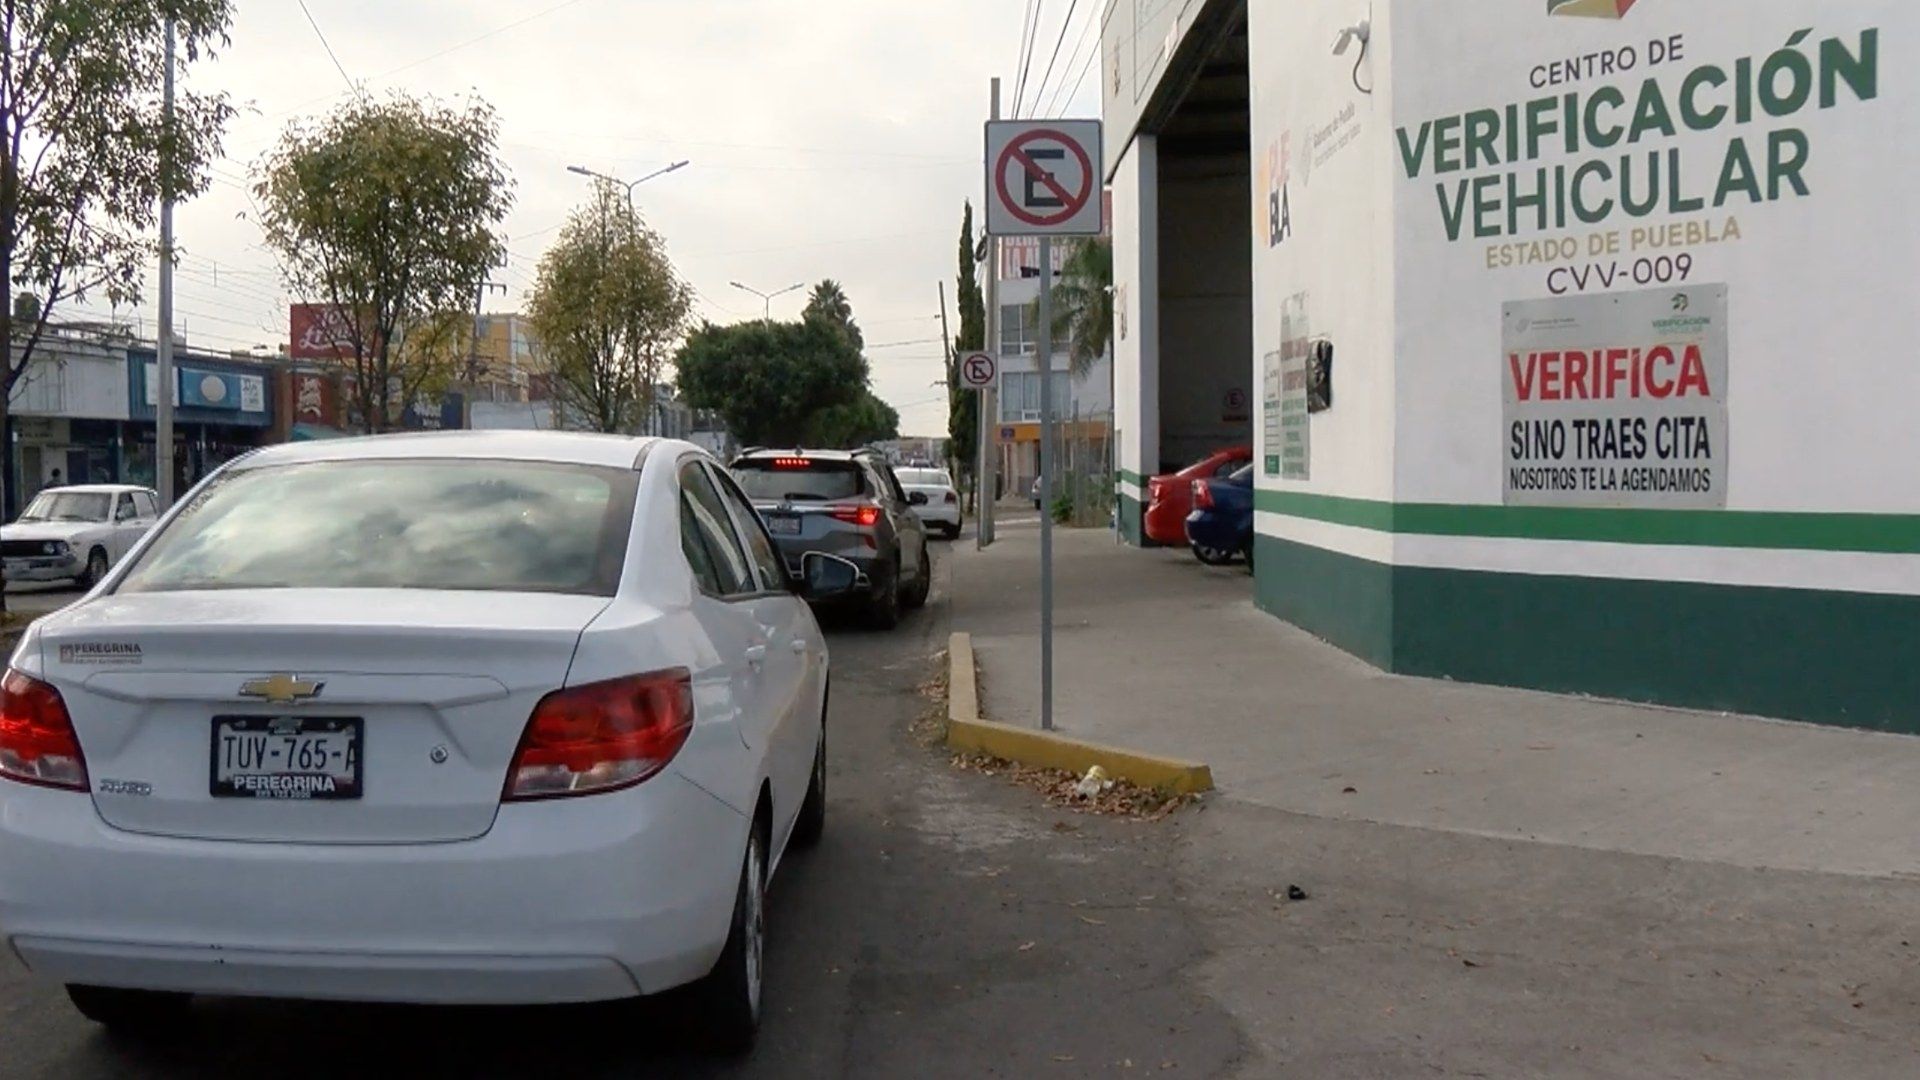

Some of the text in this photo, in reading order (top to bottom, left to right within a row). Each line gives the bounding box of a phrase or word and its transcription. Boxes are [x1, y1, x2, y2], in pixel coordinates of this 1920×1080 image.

[1528, 33, 1686, 90] CENTRO DE
[1395, 27, 1881, 179] VERIFICACIÓN
[1435, 128, 1812, 243] VEHICULAR
[1485, 215, 1743, 270] ESTADO DE PUEBLA
[1546, 252, 1695, 296] CVV-009
[1509, 344, 1711, 402] VERIFICA
[1573, 416, 1648, 461] TRAES
[1655, 415, 1712, 461] CITA
[1510, 467, 1712, 493] NOSOTROS TE LA AGENDAMOS
[74, 643, 142, 654] PEREGRINA
[234, 775, 336, 792] PEREGRINA
